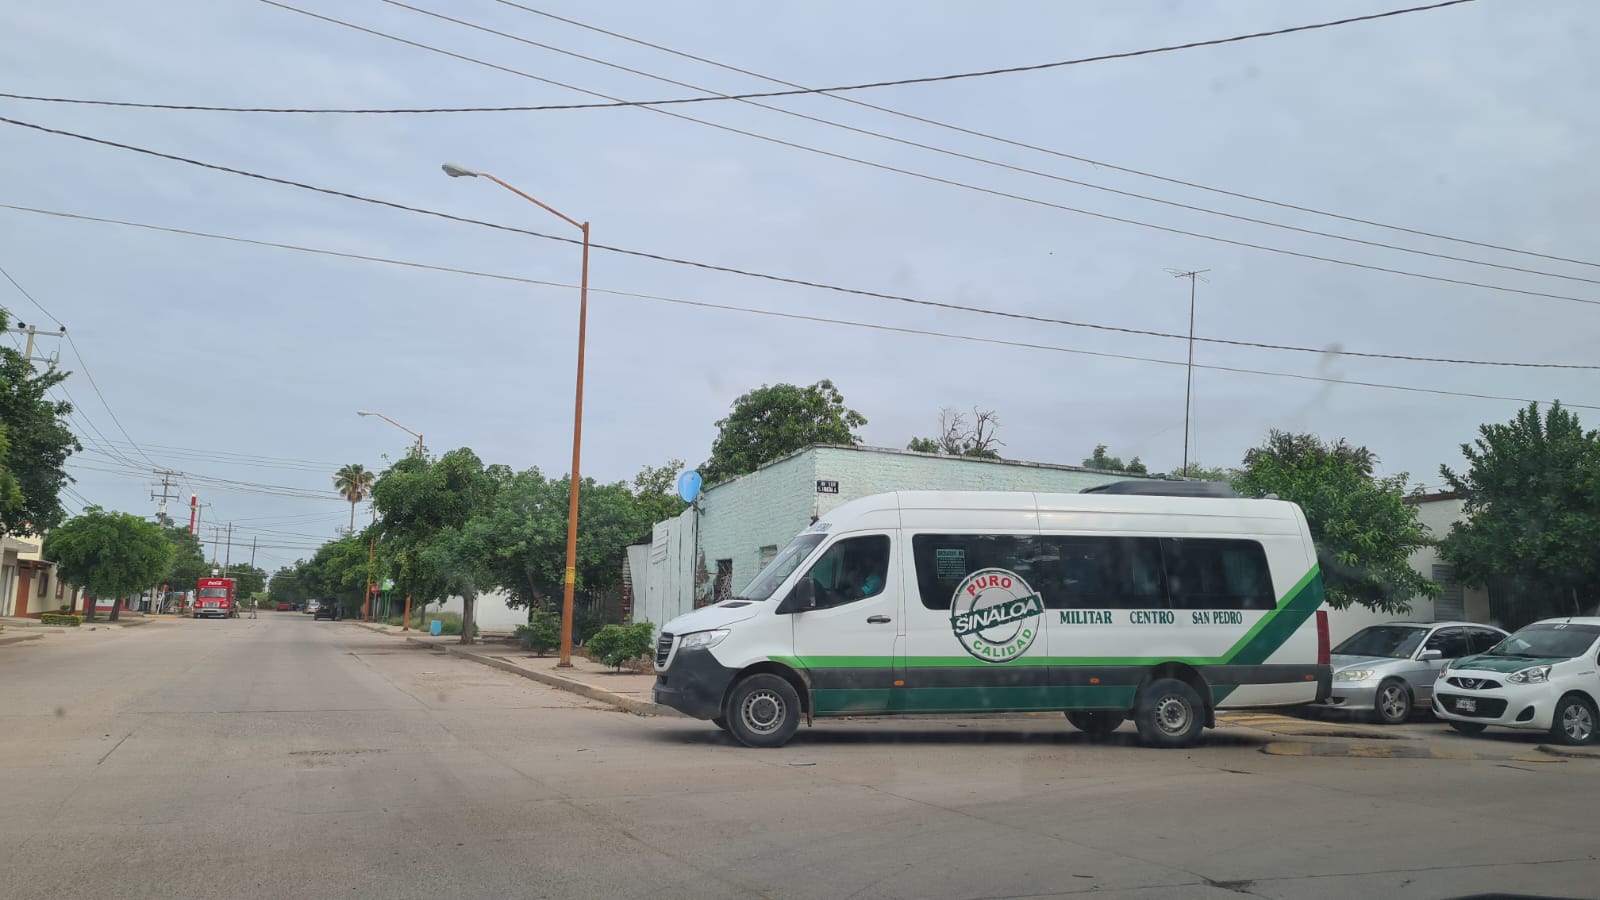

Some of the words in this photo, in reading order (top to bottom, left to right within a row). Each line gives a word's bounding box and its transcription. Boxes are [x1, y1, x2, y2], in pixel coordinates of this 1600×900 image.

[966, 575, 1012, 597] PURO
[955, 598, 1038, 634] SINALOA
[1059, 610, 1113, 625] MILITAR
[1129, 610, 1175, 625] CENTRO
[1191, 611, 1210, 625] SAN
[1213, 611, 1243, 625] PEDRO
[972, 628, 1032, 658] CALIDAD
